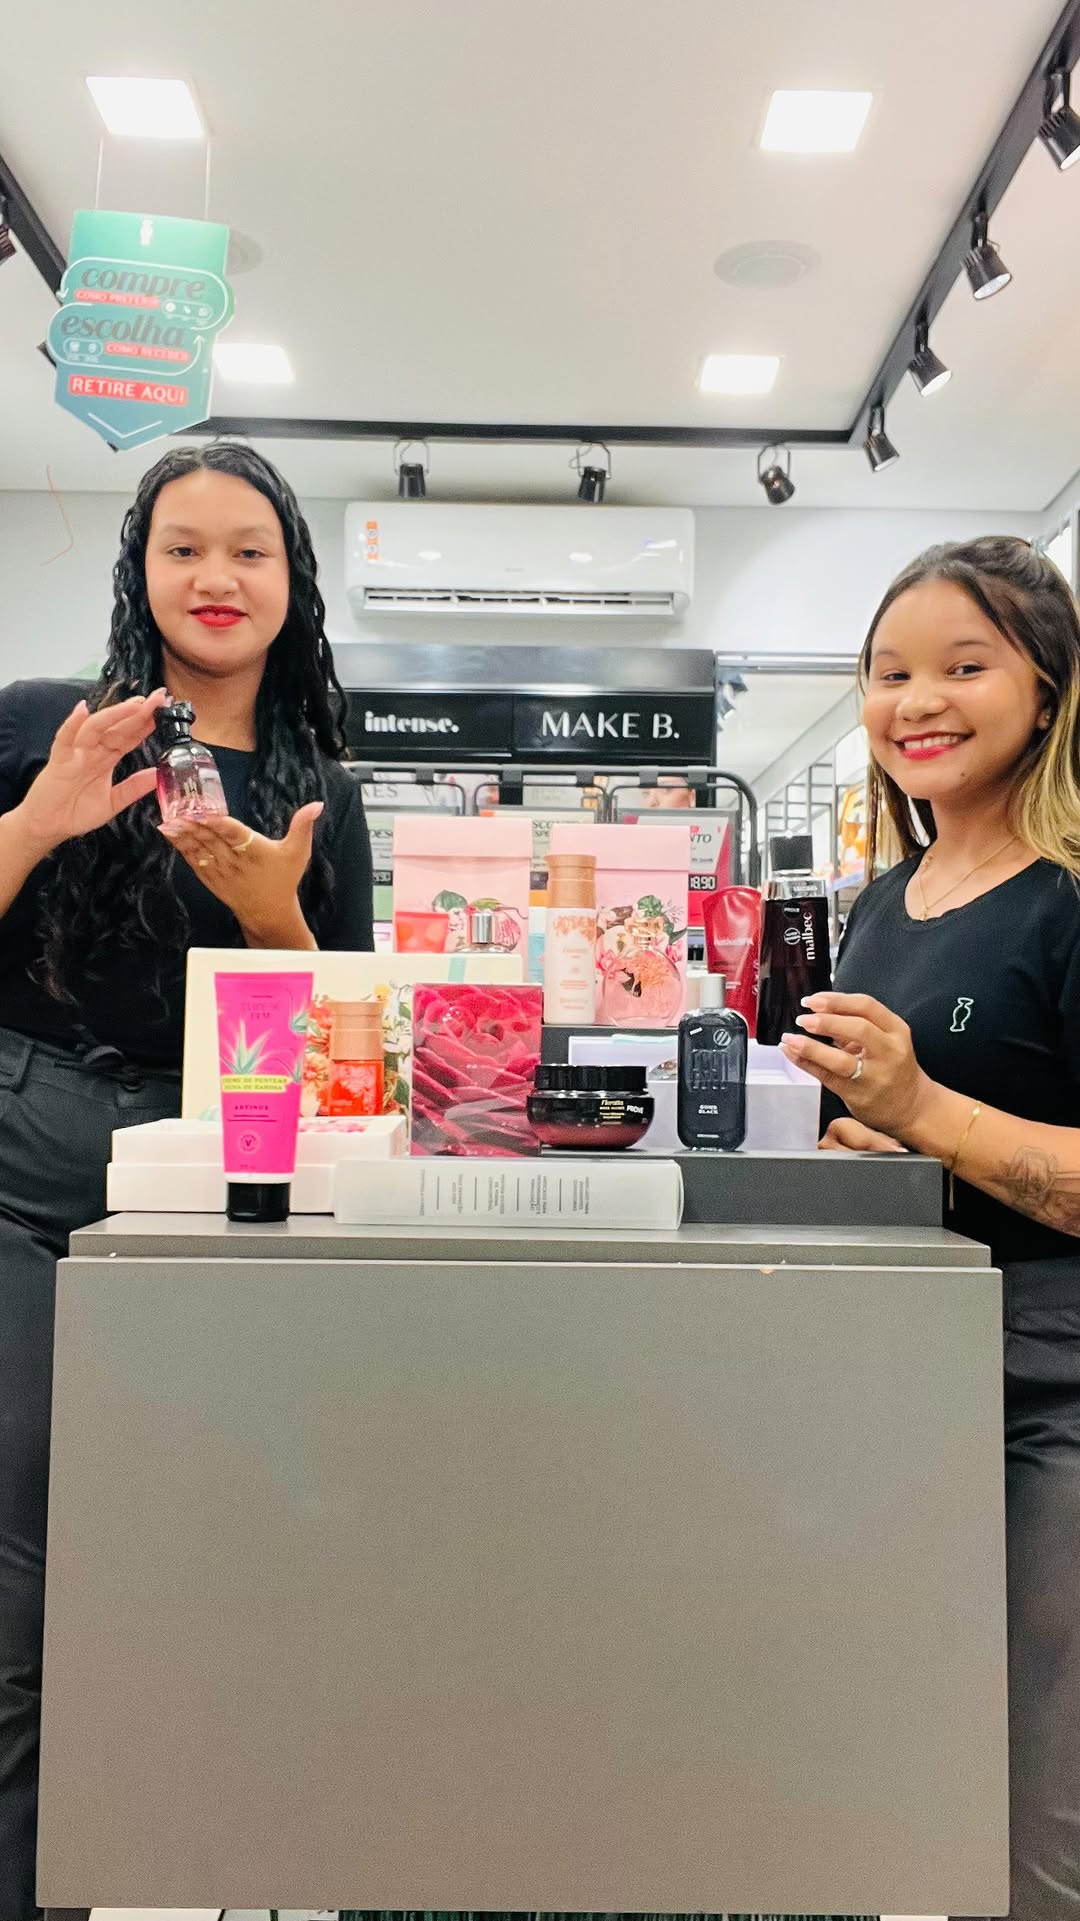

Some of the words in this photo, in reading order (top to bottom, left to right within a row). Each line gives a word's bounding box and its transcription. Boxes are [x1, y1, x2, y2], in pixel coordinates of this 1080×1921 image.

[81, 268, 206, 299] compre
[62, 314, 184, 347] escolha
[72, 377, 136, 398] RETIRE
[140, 386, 186, 404] AQUI
[364, 710, 460, 733] intense.
[542, 710, 641, 739] MAKE
[652, 712, 680, 740] B.
[801, 910, 816, 961] malbec
